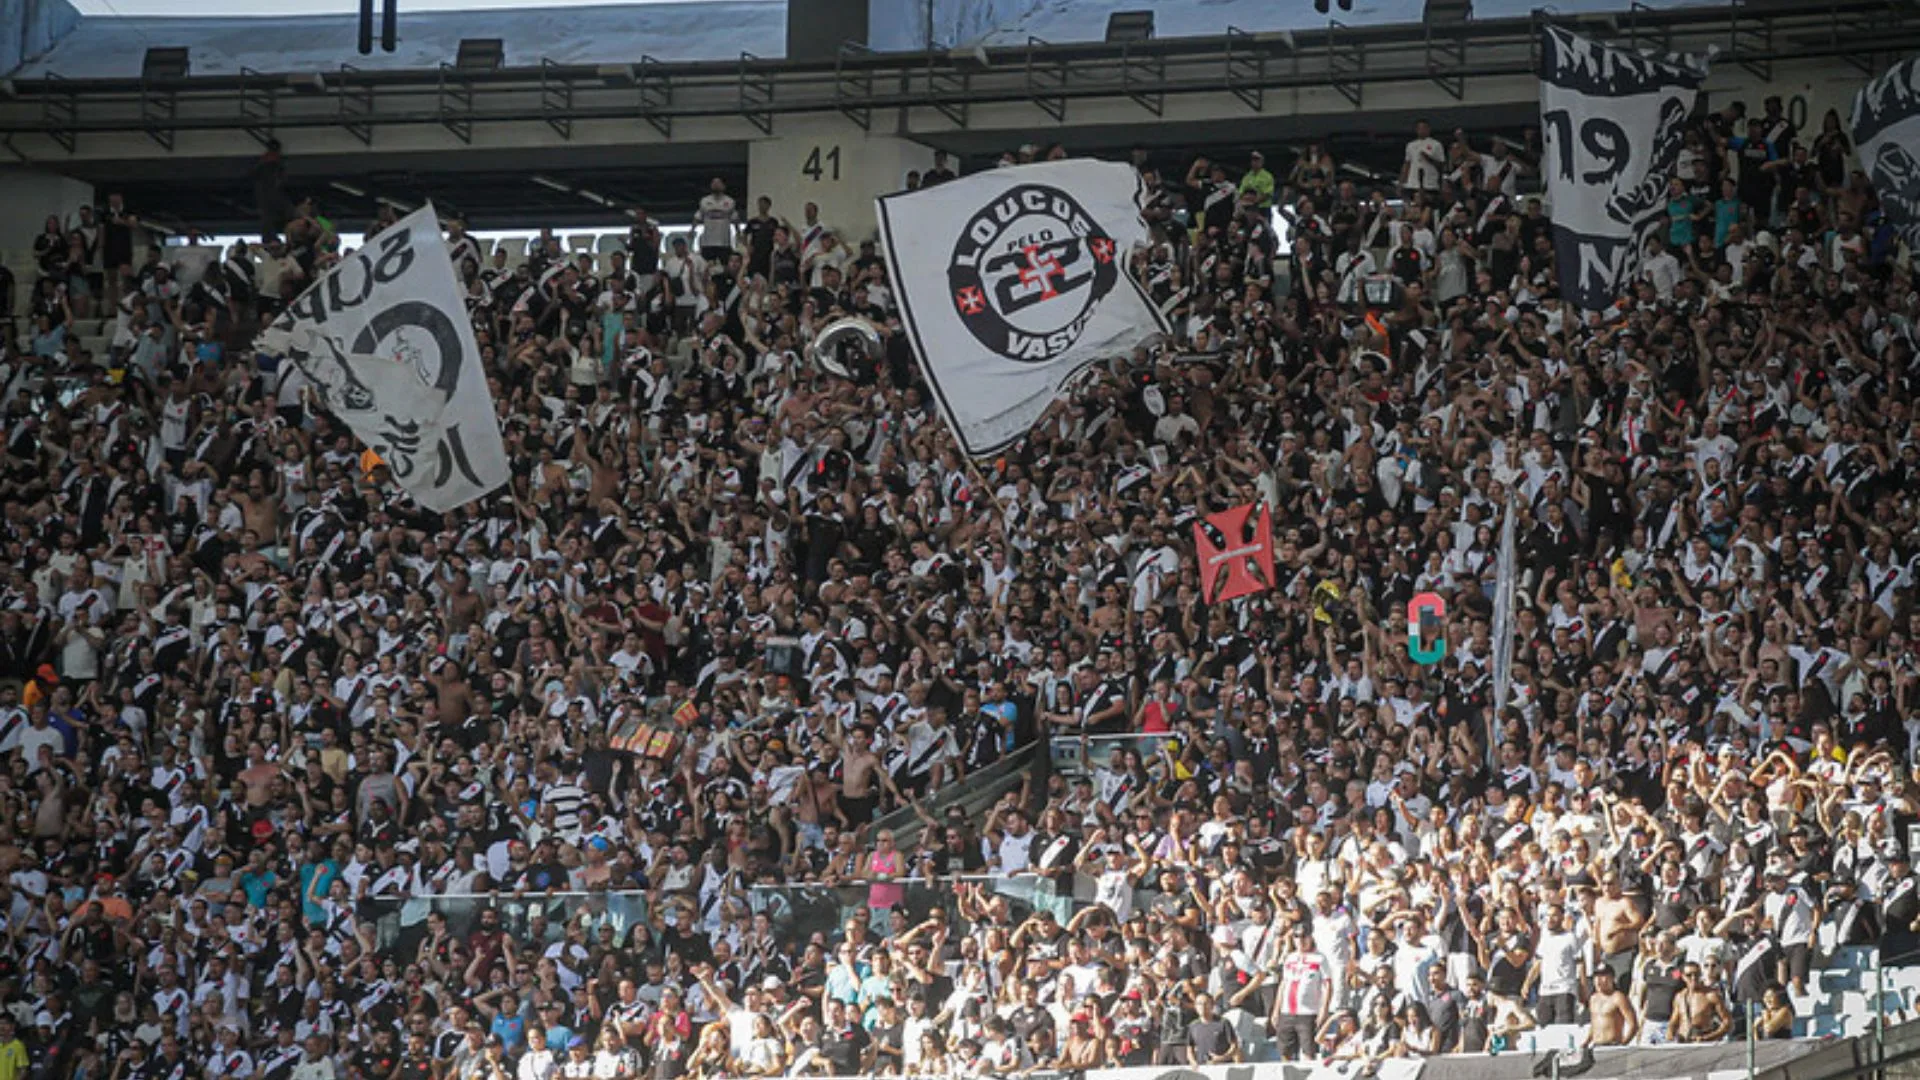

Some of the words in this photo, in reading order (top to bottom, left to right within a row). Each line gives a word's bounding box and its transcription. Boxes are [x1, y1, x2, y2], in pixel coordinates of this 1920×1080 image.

[802, 145, 840, 181] 41
[1543, 110, 1630, 186] 19
[956, 189, 1092, 267] LOUCOS
[1006, 228, 1054, 251] PELO
